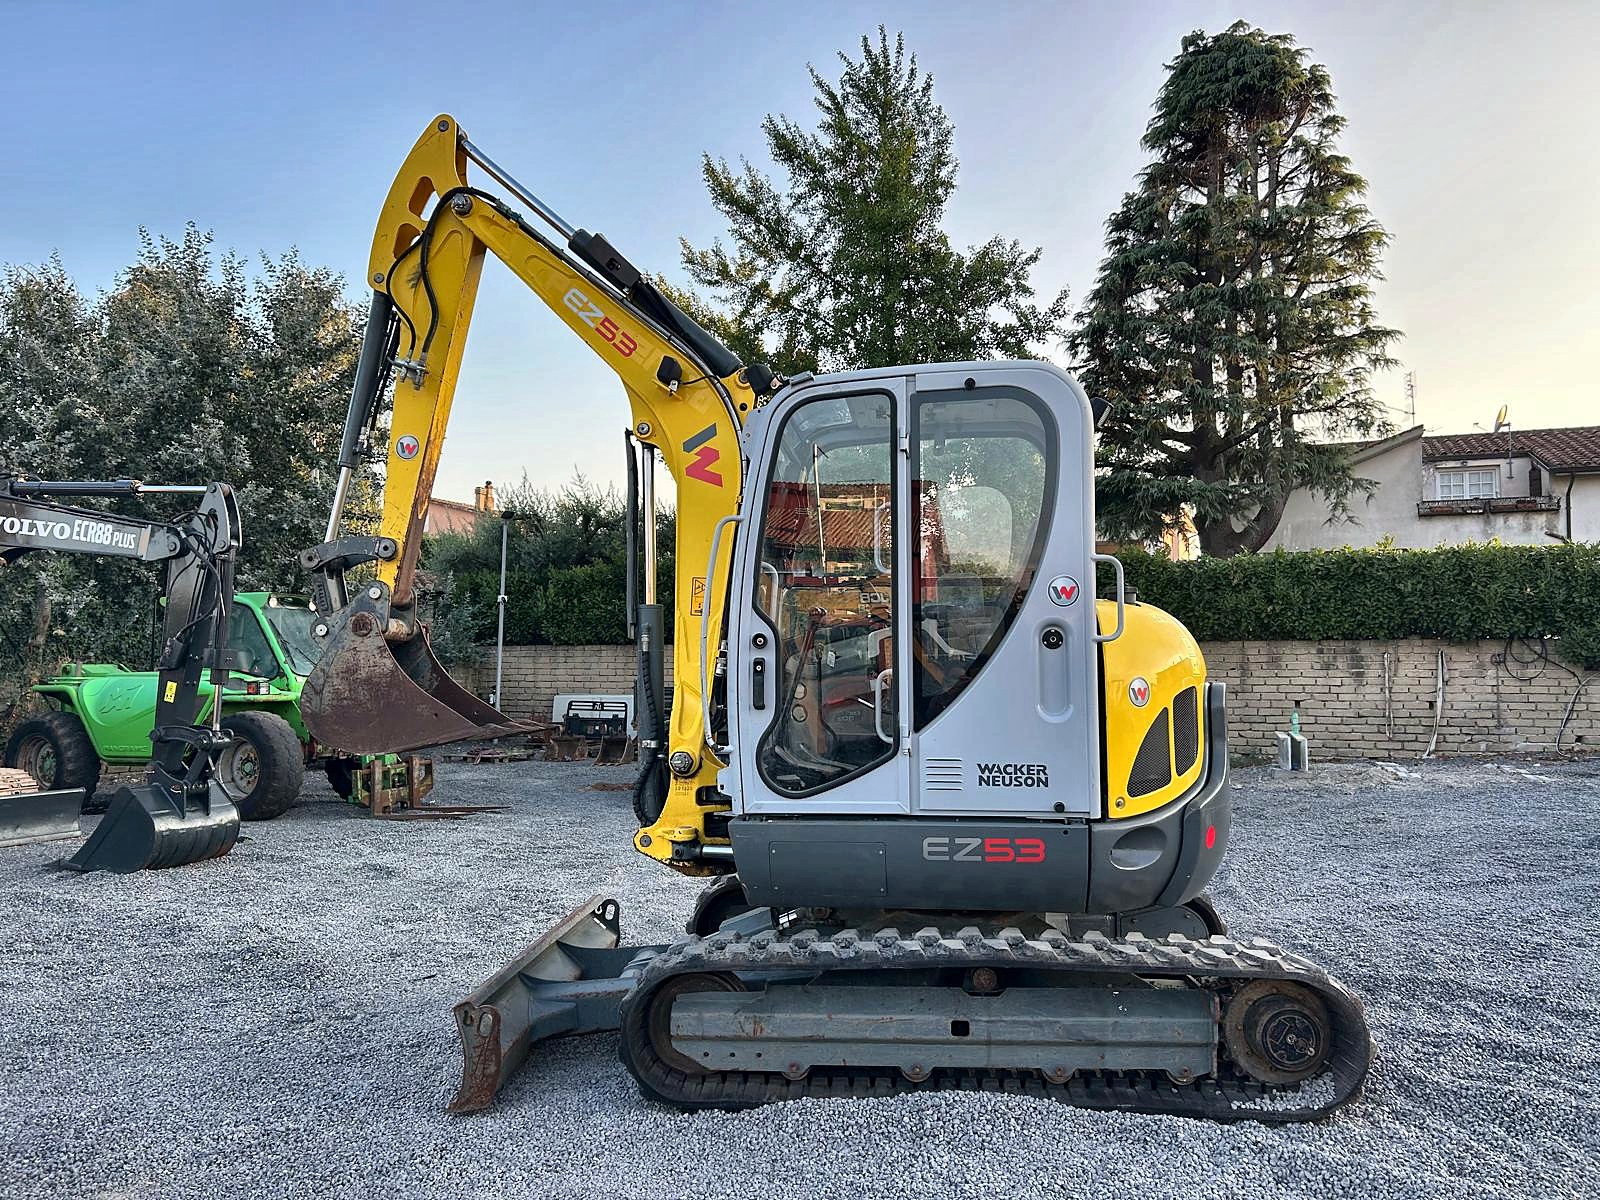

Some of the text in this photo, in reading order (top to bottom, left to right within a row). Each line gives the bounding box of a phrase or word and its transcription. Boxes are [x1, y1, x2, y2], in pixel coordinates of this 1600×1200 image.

[562, 287, 638, 358] EZ53
[71, 519, 113, 545] ECR88
[111, 531, 136, 549] PLUS
[976, 763, 1048, 776] WACKER
[978, 774, 1049, 788] NEUSON
[922, 837, 1046, 862] EZ53
